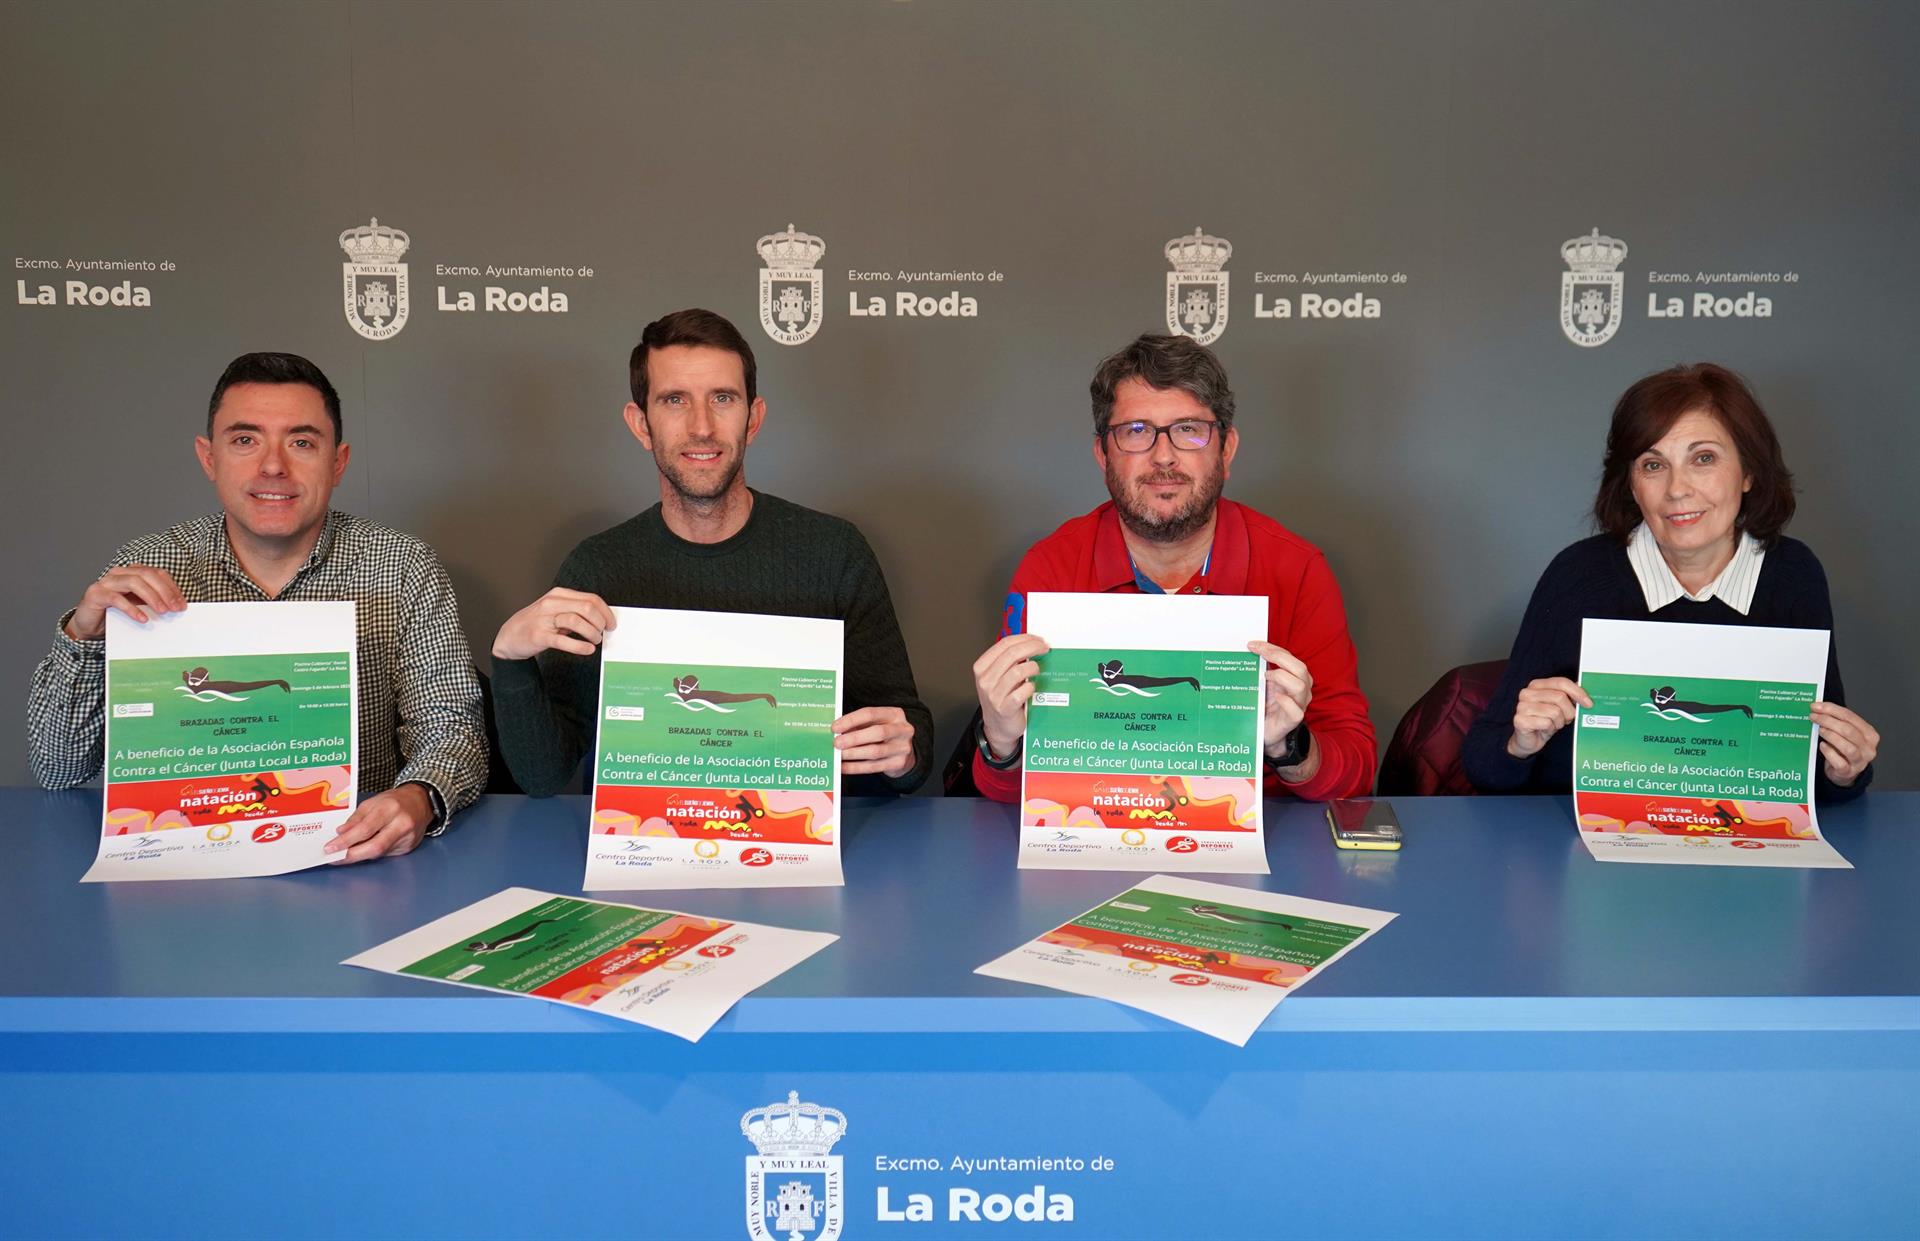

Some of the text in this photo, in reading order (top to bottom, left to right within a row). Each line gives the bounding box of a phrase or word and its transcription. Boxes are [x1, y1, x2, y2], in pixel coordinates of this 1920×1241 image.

[15, 257, 176, 271] Excmo. Ayuntamiento de
[436, 264, 594, 278] Excmo. Ayuntamiento de
[848, 269, 1004, 283] Excmo. Ayuntamiento de
[1255, 271, 1407, 285] Excmo. Ayuntamiento de
[1648, 271, 1799, 284] Excmo. Ayuntamiento de
[17, 279, 151, 307] La Roda
[437, 286, 568, 312] La Roda
[849, 291, 978, 317] La Roda
[1255, 292, 1381, 318] La Roda
[1648, 291, 1772, 317] La Roda
[359, 324, 398, 337] LA RODA
[773, 329, 811, 341] LA RODA
[180, 717, 224, 727] BRAZADAS
[229, 716, 263, 724] CONTRA
[1093, 711, 1136, 720] BRAZADAS
[1177, 713, 1187, 721] EL
[213, 727, 247, 736] CÁNCER
[668, 727, 764, 738] BRAZADAS CONTRA EL
[1124, 721, 1156, 731] CÁNCER
[114, 736, 344, 760] A beneficio de la Asociación Española
[699, 737, 732, 747] CÁNCER
[1032, 737, 1250, 756] A beneficio de la Asociación Española
[1643, 735, 1738, 747] BRAZADAS CONTRA EL
[1674, 746, 1707, 756] CÁNCER
[112, 752, 347, 777] Contra el Cáncer (Junta Local La Roda)
[604, 751, 828, 770] A beneficio de la Asociación Española
[1030, 754, 1251, 774] Contra el Cáncer (Junta Local La Roda)
[602, 768, 829, 787] Contra el Cáncer (Junta Local La Roda)
[1582, 760, 1801, 782] A beneficio de la Asociación Española
[1581, 776, 1803, 799] Contra el Cáncer (Junta Local La Roda)
[180, 790, 256, 807] natación
[1093, 793, 1165, 807] natación
[666, 806, 741, 820] natación
[1647, 811, 1720, 825] natación
[595, 853, 673, 864] Centro Deportivo
[1122, 942, 1202, 961] natación
[600, 947, 654, 975] natación
[760, 1161, 829, 1169] Y MUY LEAL
[876, 1155, 1114, 1175] Excmo. Ayuntamiento de
[751, 1171, 764, 1236] MUY NOBLE
[766, 1201, 825, 1217] R F
[828, 1171, 838, 1235] VILLA DE
[877, 1185, 1074, 1222] La Roda
